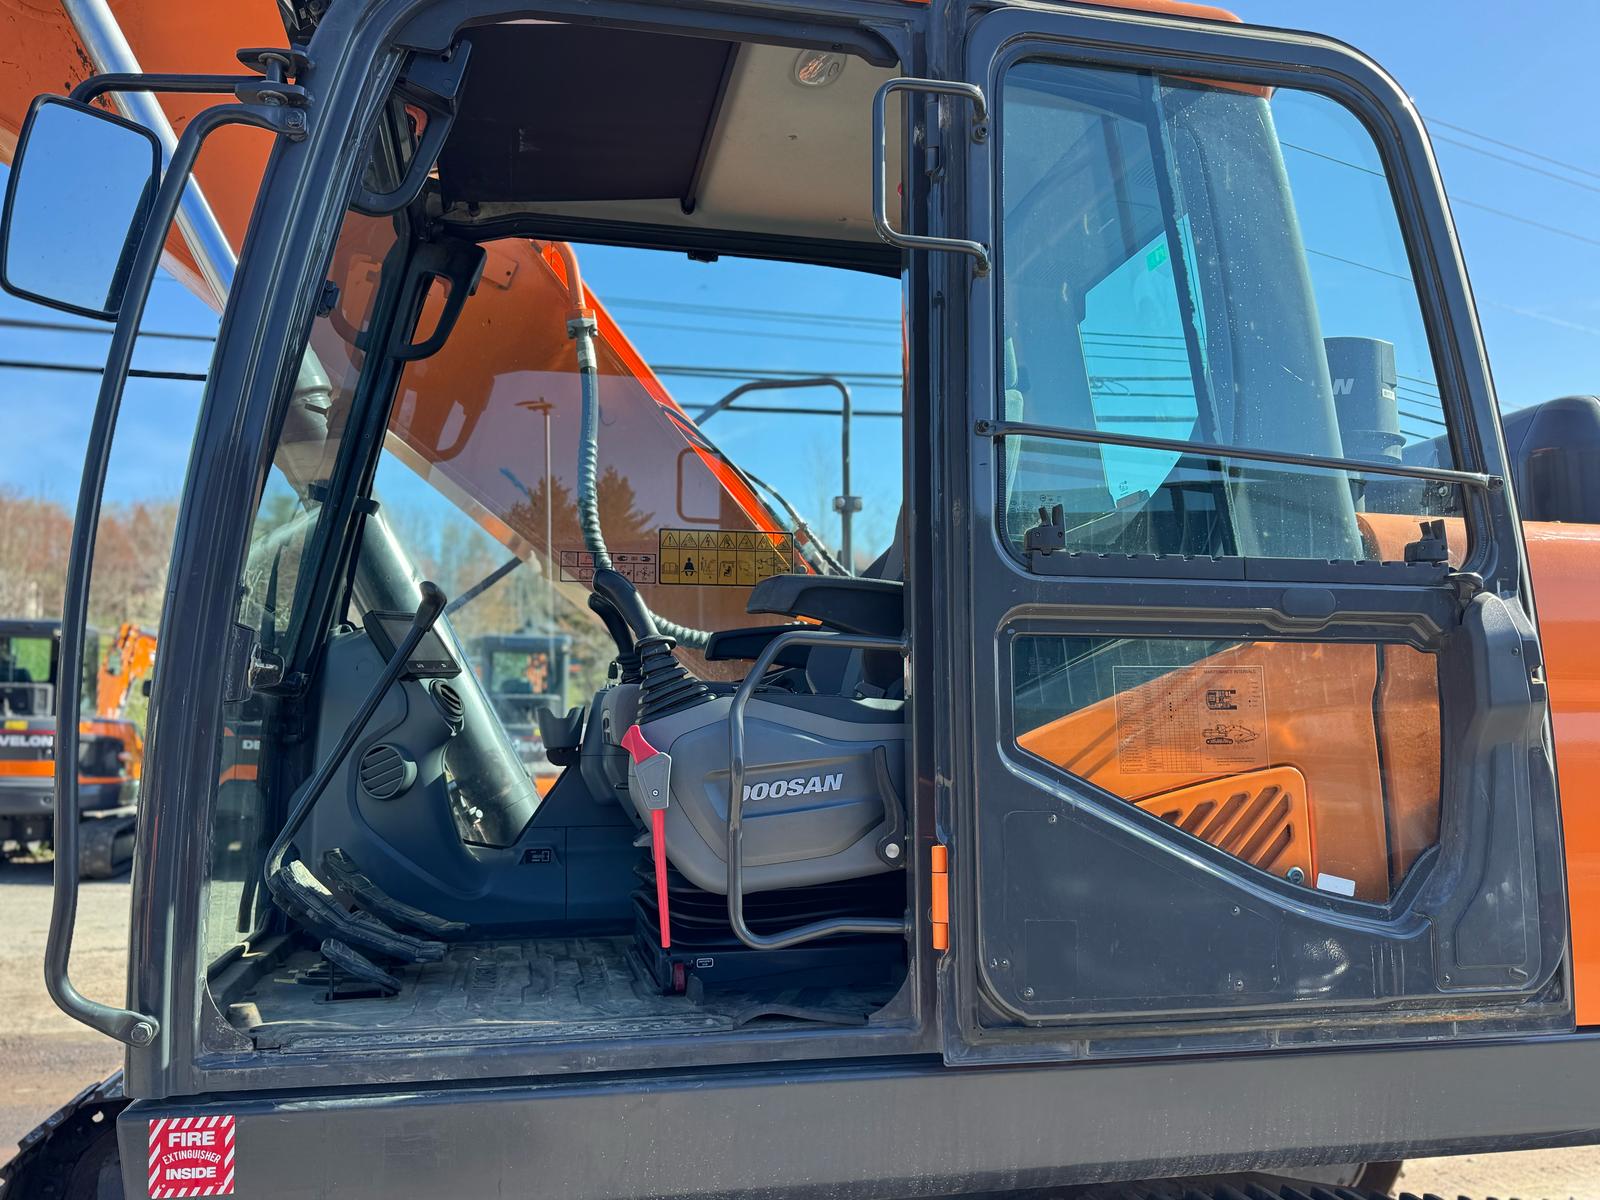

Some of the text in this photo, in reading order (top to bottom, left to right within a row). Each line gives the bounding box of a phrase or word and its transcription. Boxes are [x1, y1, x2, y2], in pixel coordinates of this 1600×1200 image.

[168, 1130, 216, 1147] FIRE
[161, 1149, 221, 1165] EXTINGUISHER
[165, 1166, 217, 1180] INSIDE
